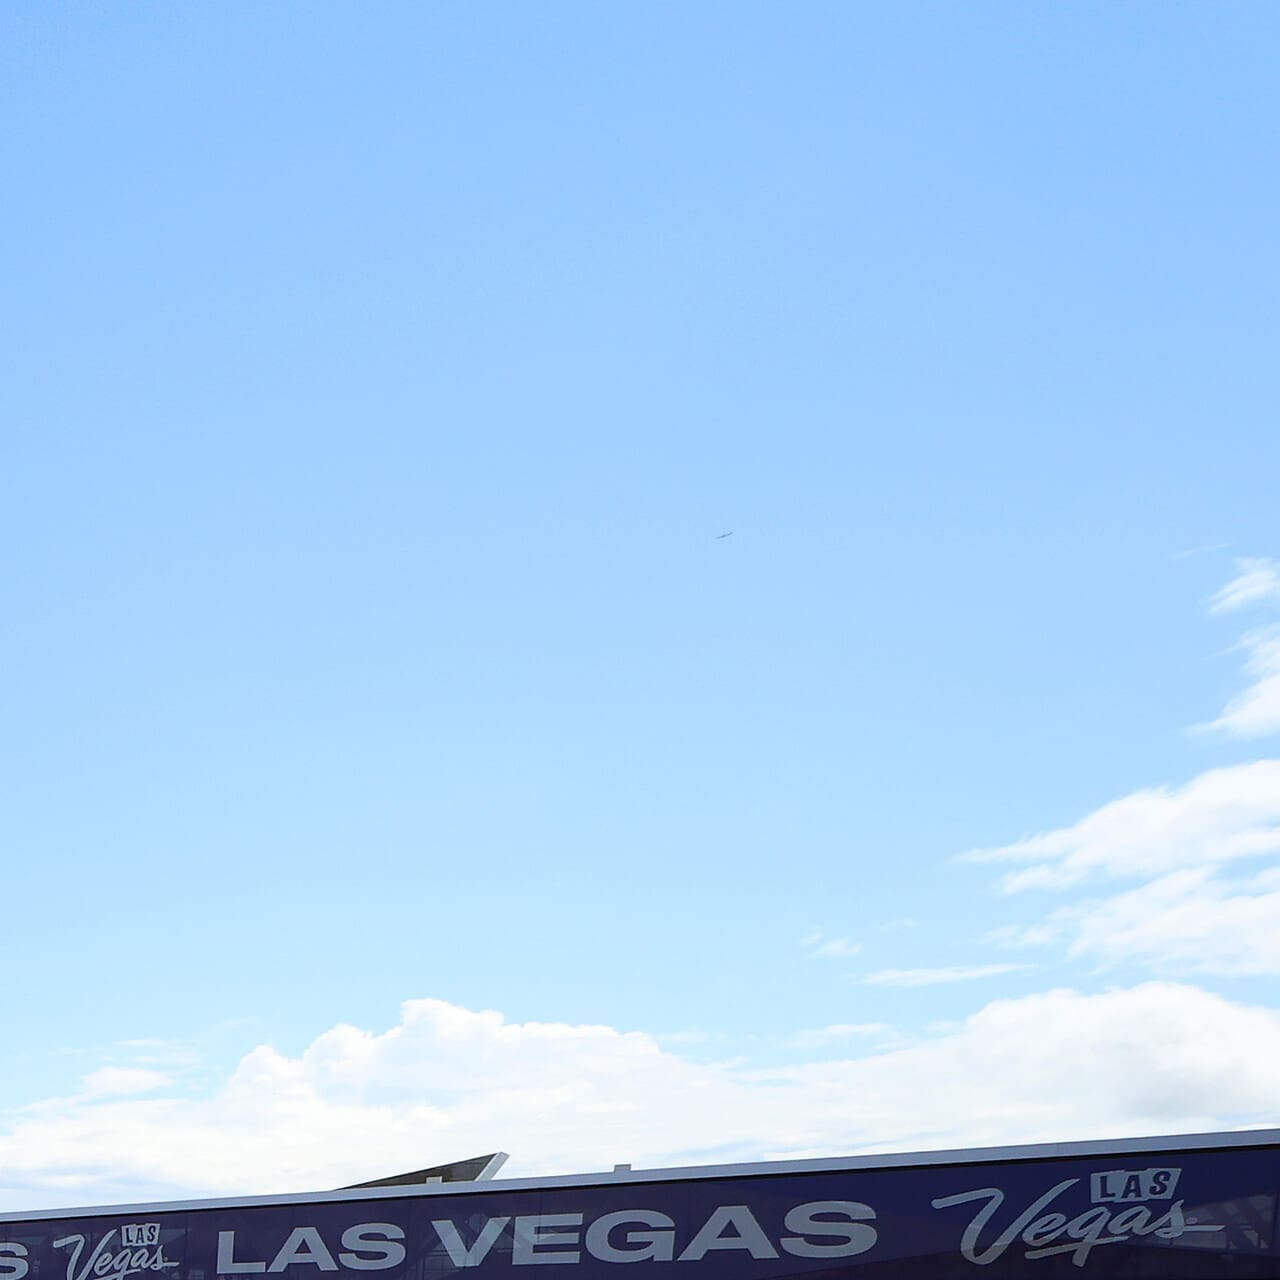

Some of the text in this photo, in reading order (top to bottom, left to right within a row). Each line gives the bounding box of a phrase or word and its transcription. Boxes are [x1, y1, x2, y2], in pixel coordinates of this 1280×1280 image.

[1091, 1166, 1181, 1202] LAS
[120, 1222, 160, 1246] LAS
[217, 1201, 877, 1274] LAS VEGAS
[933, 1187, 1224, 1267] Vegas
